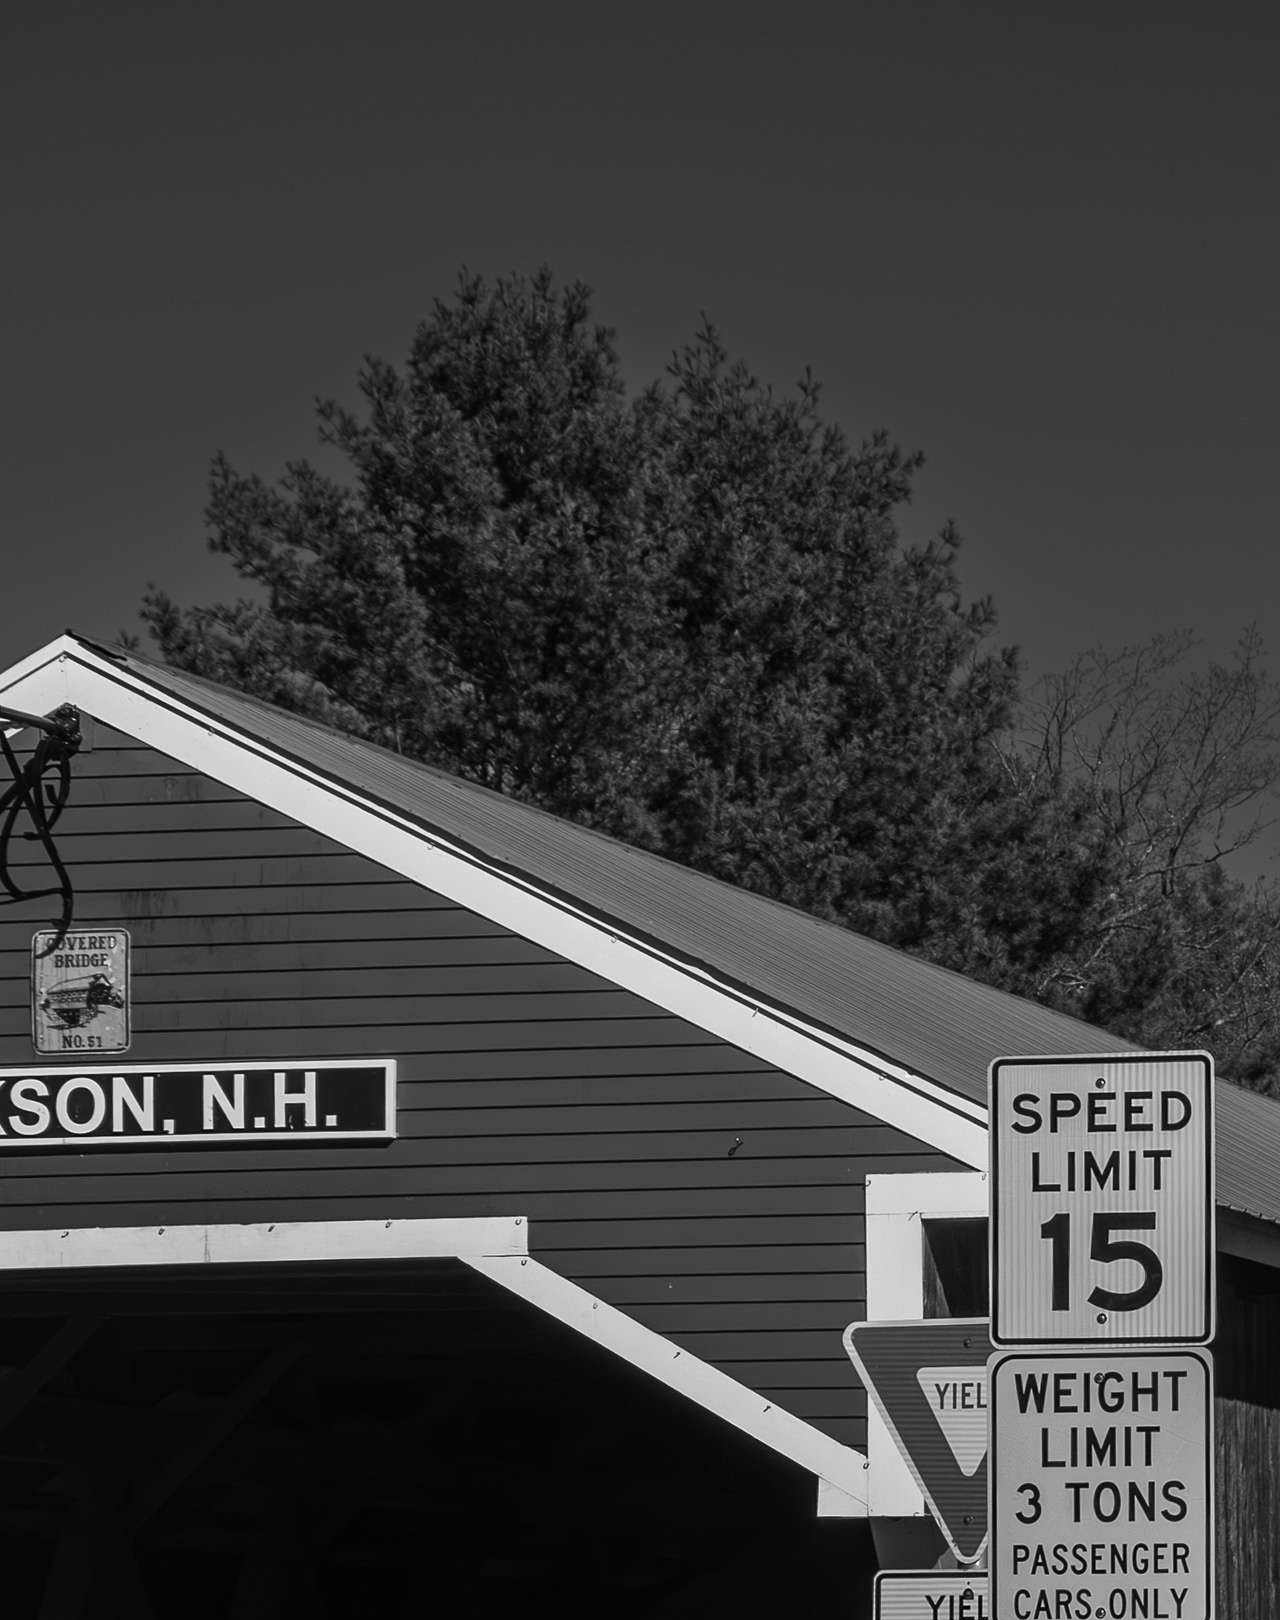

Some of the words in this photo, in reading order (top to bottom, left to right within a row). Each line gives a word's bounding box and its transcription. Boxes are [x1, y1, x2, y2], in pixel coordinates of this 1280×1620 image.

[54, 953, 109, 968] BRIDGE
[88, 1036, 103, 1047] 51
[202, 1071, 338, 1130] N.H.
[1011, 1091, 1192, 1135] SPEED
[1032, 1150, 1172, 1192] LIMIT
[1040, 1211, 1163, 1312] 15
[934, 1381, 988, 1410] YIEL
[1014, 1370, 1188, 1414] WEIGHT
[1041, 1426, 1160, 1468] LIMIT
[1014, 1482, 1042, 1525] 3
[1065, 1480, 1188, 1523] TONS
[1012, 1543, 1190, 1576] PASSENGER
[1013, 1588, 1092, 1620] CARS
[1109, 1587, 1189, 1619] ONLY
